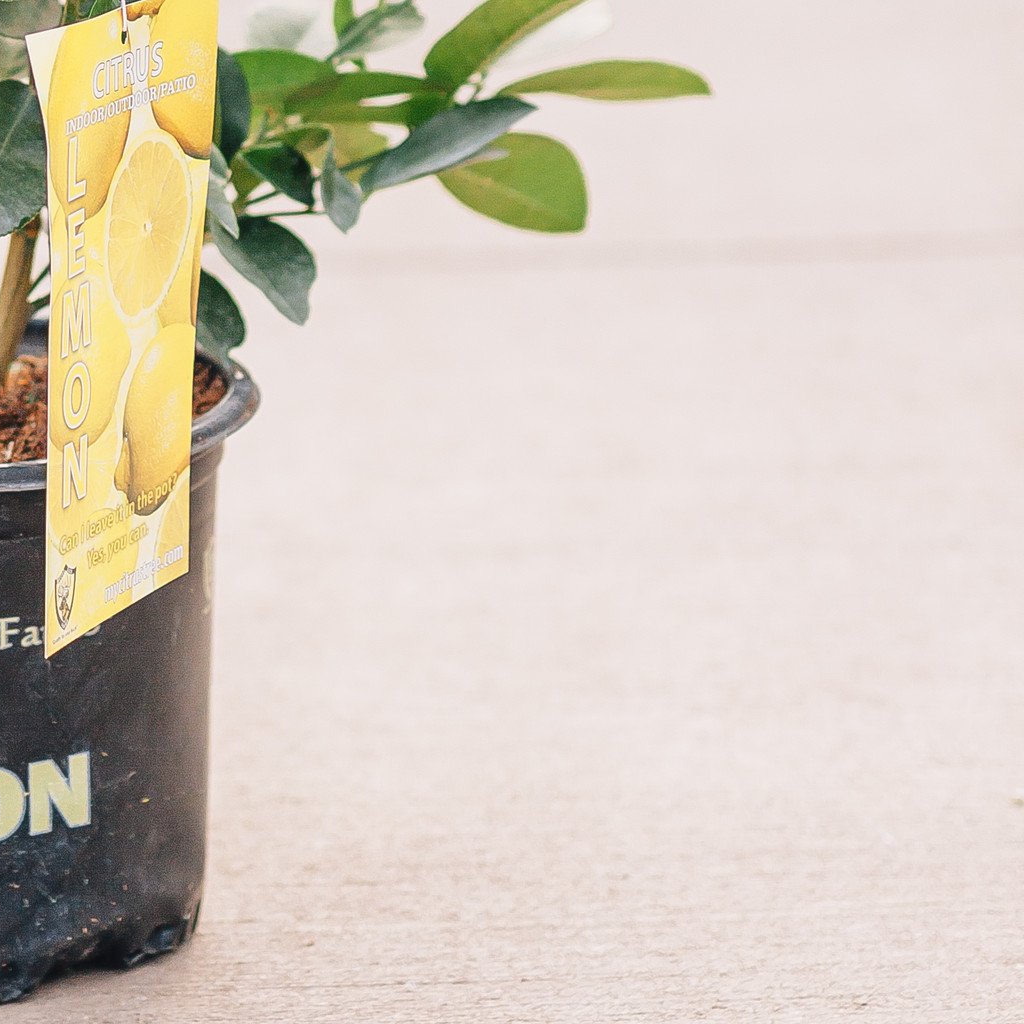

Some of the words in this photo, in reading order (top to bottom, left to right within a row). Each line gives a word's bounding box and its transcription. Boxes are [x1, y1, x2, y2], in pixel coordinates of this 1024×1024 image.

[92, 41, 164, 100] CITRUS
[65, 73, 197, 136] INDOOR/OUTDOOR/PATIO
[60, 135, 92, 509] LEMON
[58, 531, 79, 556] Can
[81, 521, 85, 545] I
[86, 512, 115, 541] leave
[116, 502, 124, 522] it
[125, 497, 135, 519] in
[137, 489, 154, 511] the
[155, 472, 178, 505] pot?
[86, 546, 107, 570] Yes,
[107, 535, 127, 563] you
[129, 522, 149, 545] can.
[104, 544, 184, 604] mycitrustree.com
